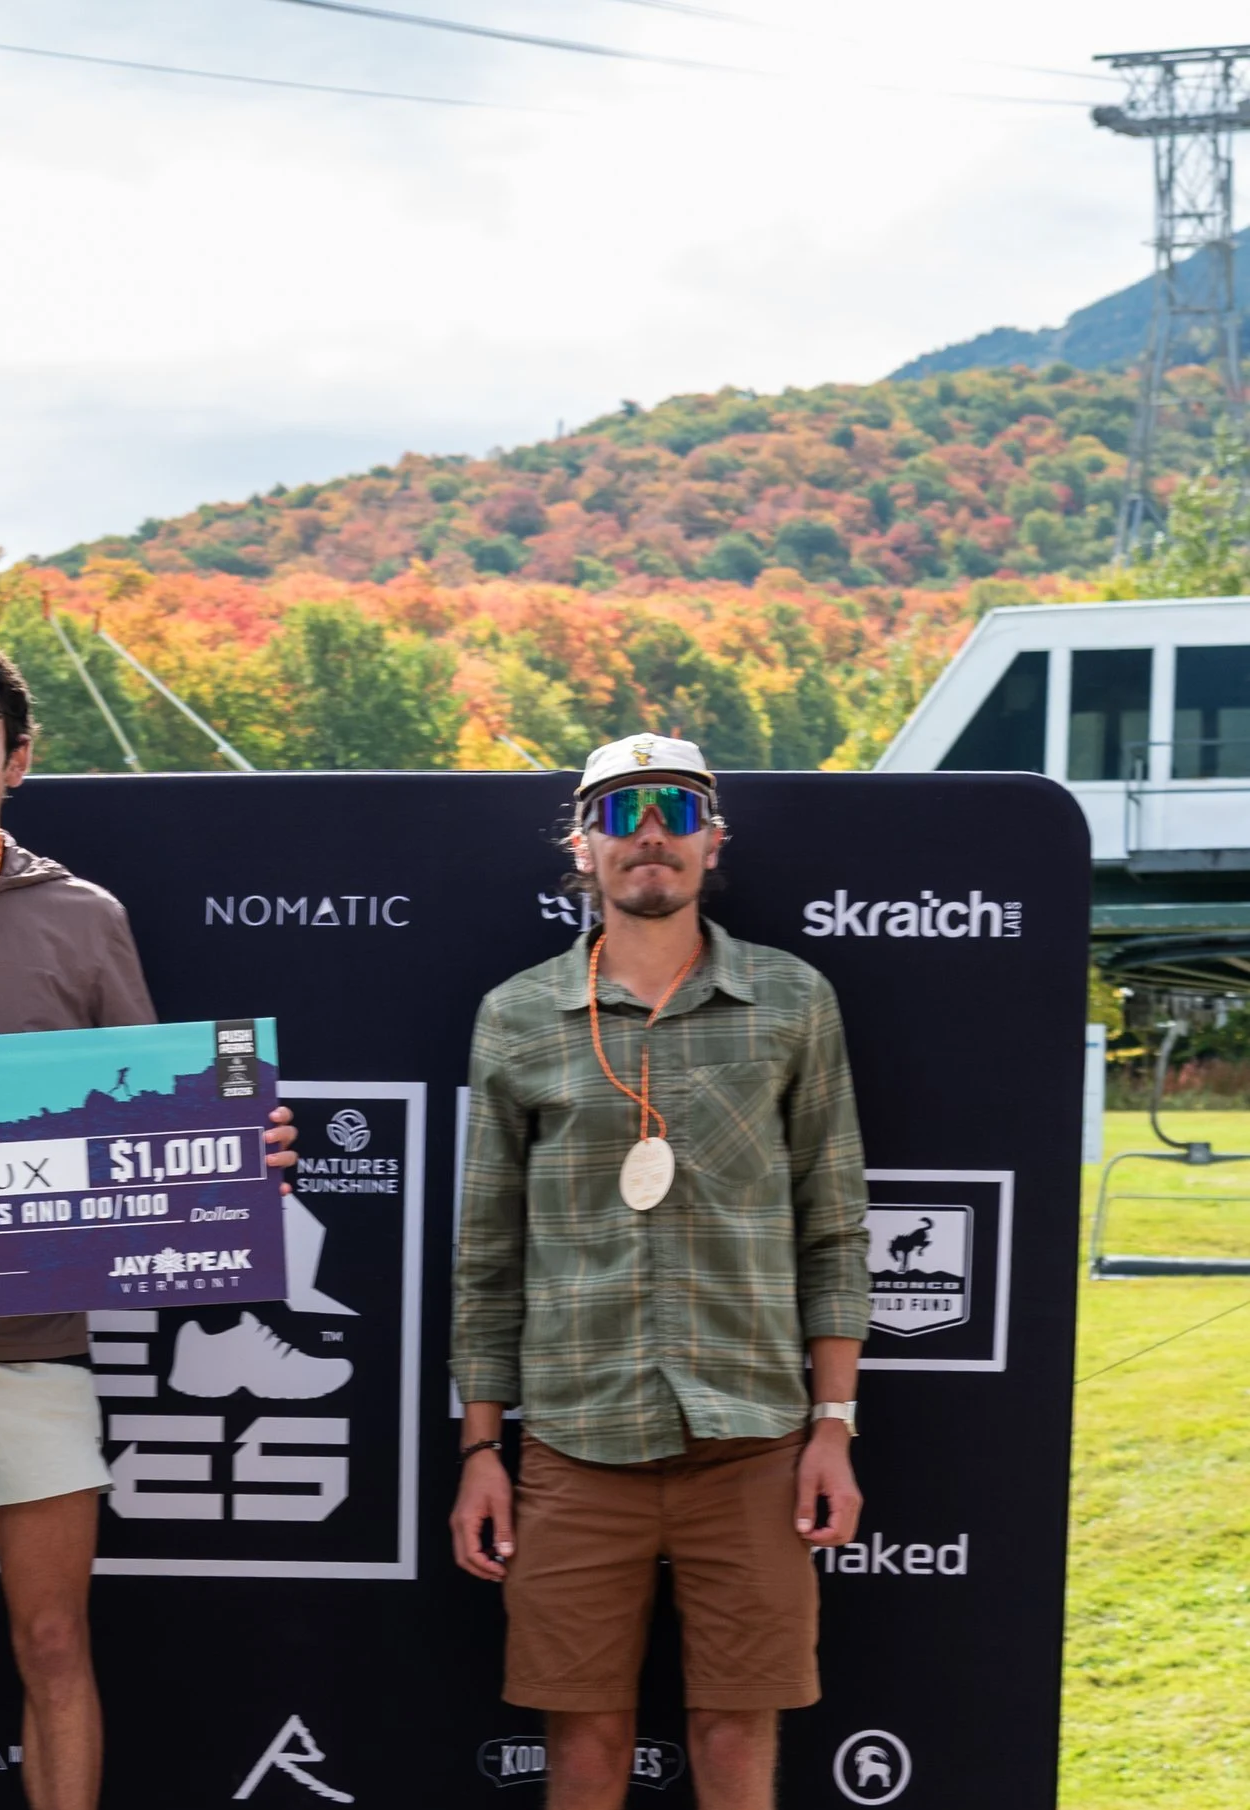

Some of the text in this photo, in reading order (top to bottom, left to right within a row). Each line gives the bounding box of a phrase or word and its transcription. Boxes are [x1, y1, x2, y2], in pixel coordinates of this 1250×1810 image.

[205, 895, 411, 928] NOMATIC
[802, 889, 1003, 937] skratch
[1003, 901, 1022, 937] LABS
[109, 1136, 242, 1183] $1,000
[297, 1158, 398, 1174] NATURES
[297, 1178, 398, 1193] SUNSHINE
[21, 1200, 72, 1223] AND
[190, 1206, 250, 1222] Dollars
[108, 1248, 252, 1277] JAY PEAK
[120, 1276, 240, 1294] VERMONT
[871, 1281, 960, 1290] RONCO
[501, 1745, 546, 1776] KOD
